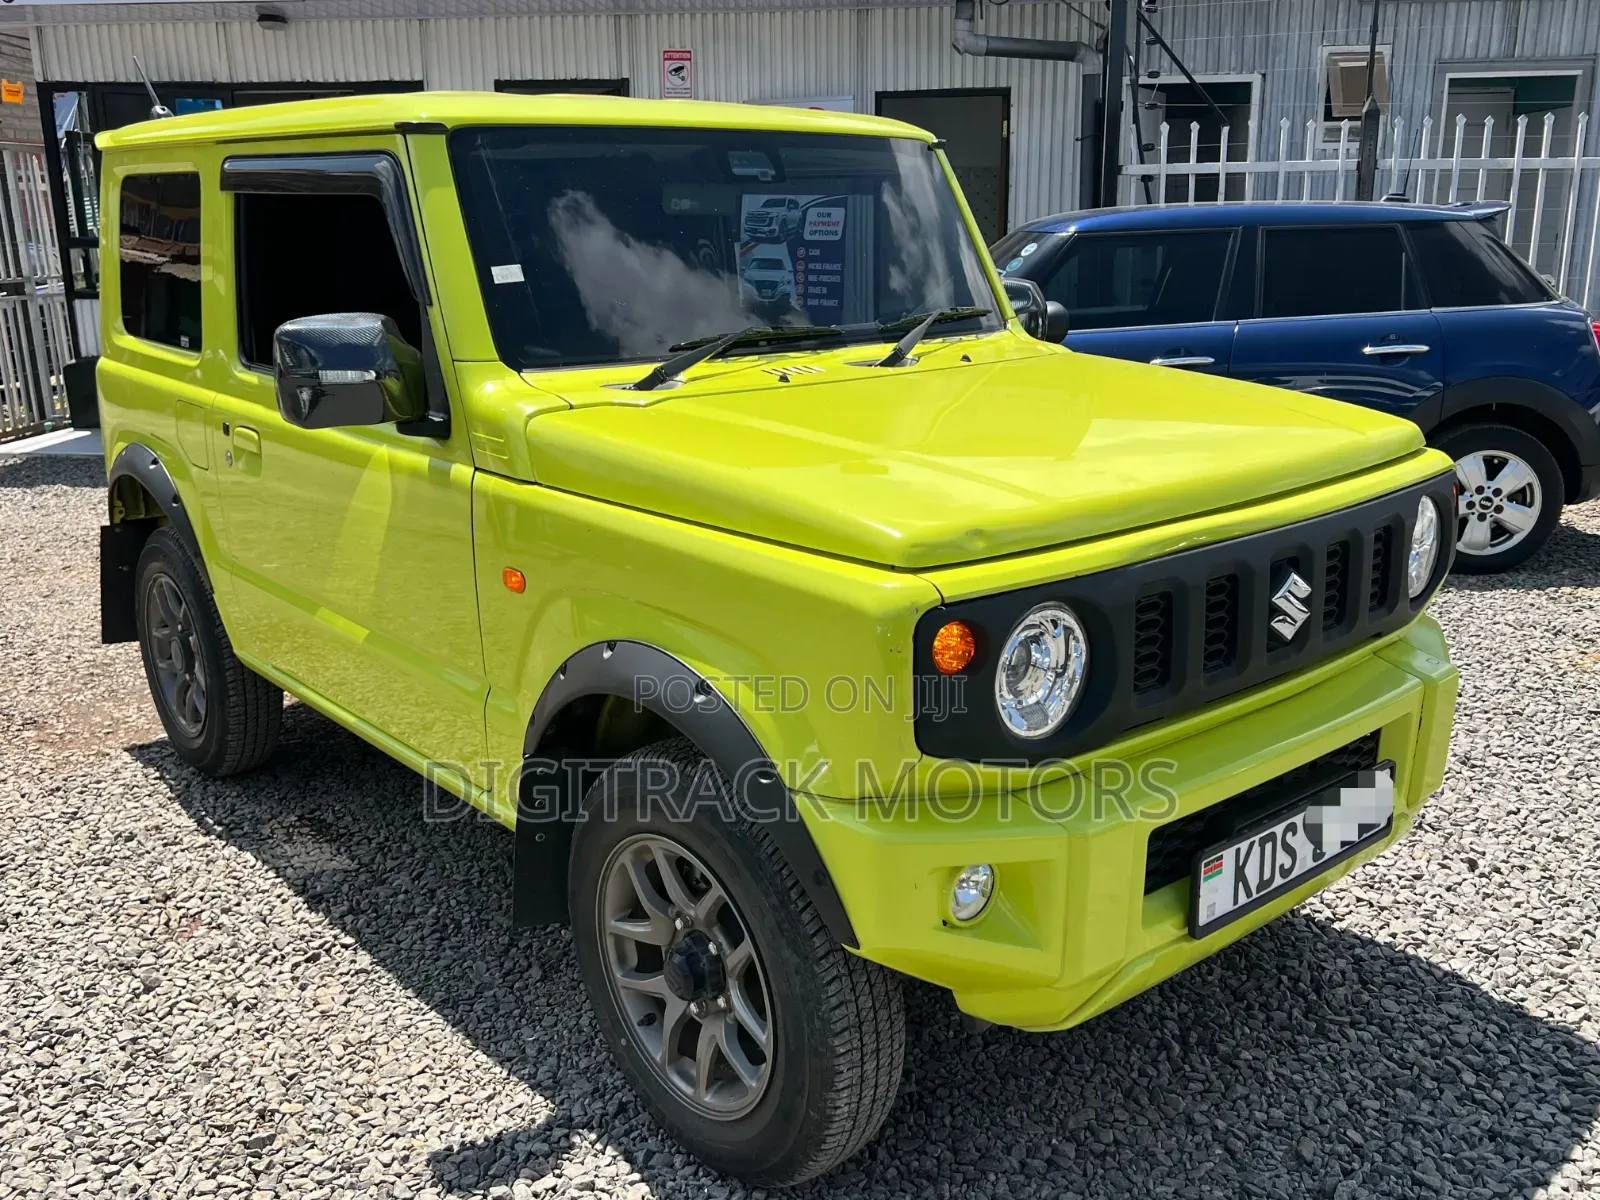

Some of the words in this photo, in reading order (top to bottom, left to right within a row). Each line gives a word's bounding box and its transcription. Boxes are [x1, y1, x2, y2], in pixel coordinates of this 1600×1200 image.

[808, 248, 820, 256] CASH
[807, 262, 822, 270] MICRO
[822, 262, 842, 271] FINANCE
[807, 286, 821, 294] TRADE
[820, 299, 839, 307] FINANCE
[1232, 821, 1298, 907] KDS
